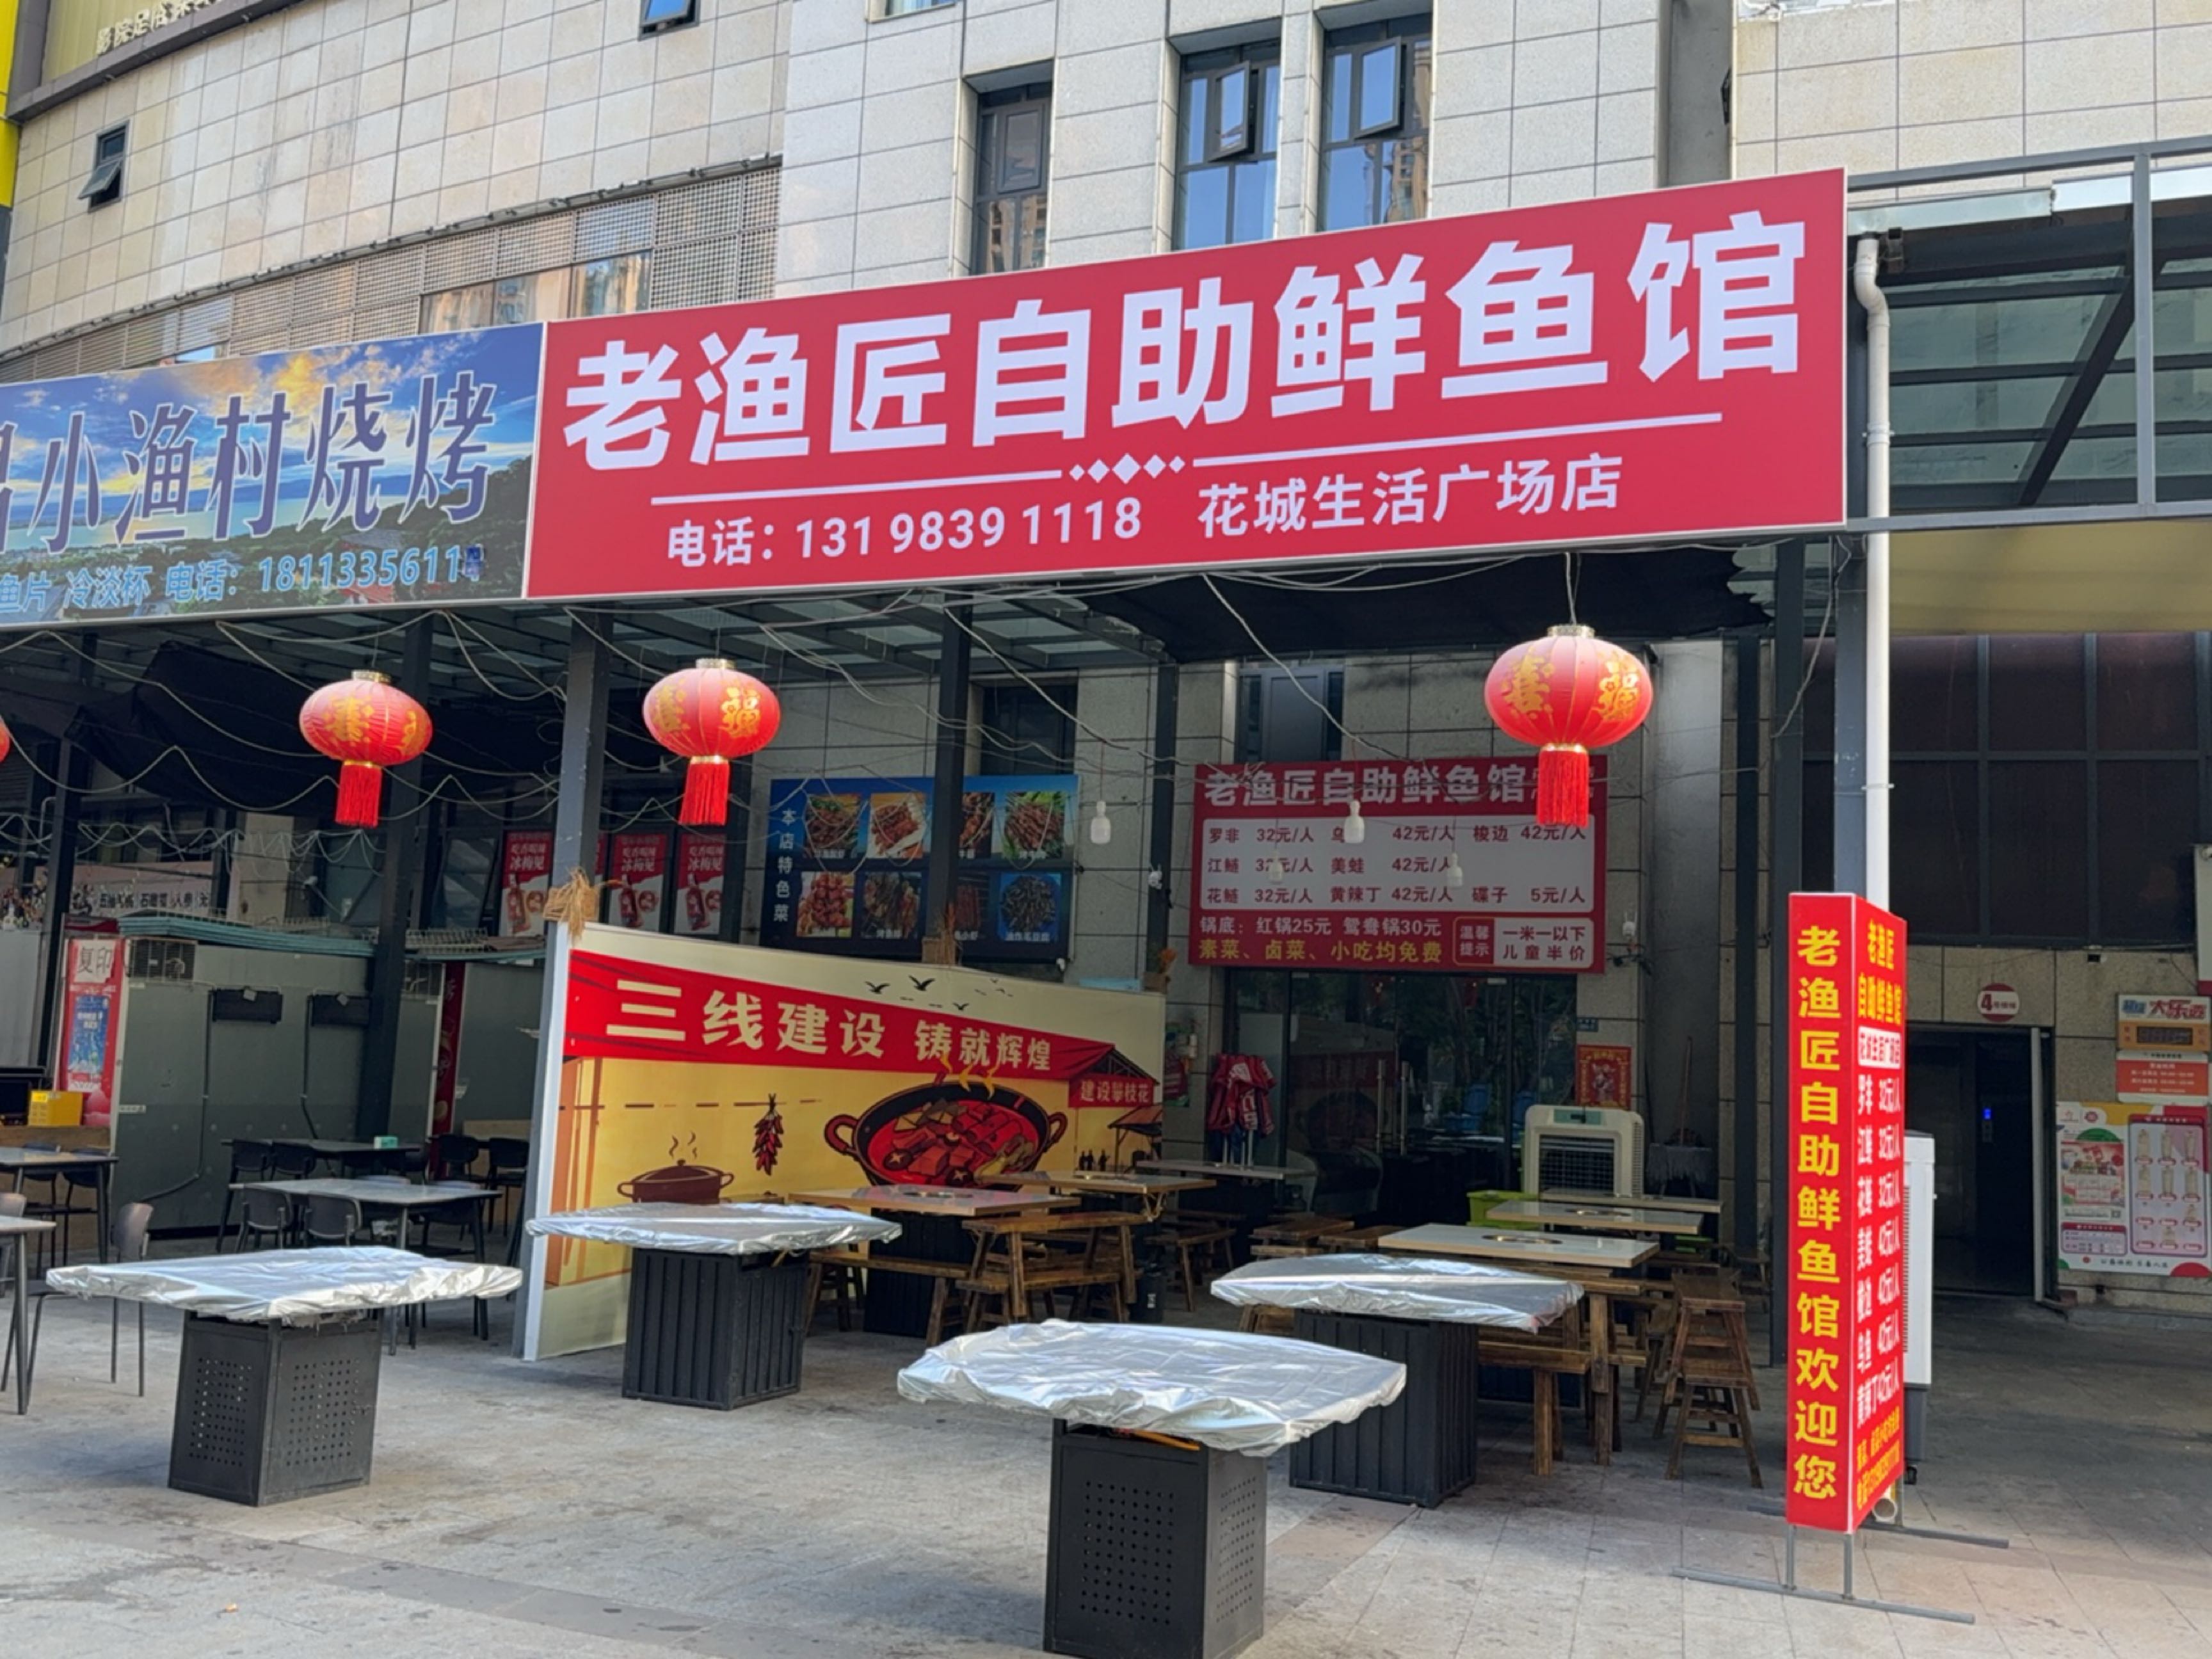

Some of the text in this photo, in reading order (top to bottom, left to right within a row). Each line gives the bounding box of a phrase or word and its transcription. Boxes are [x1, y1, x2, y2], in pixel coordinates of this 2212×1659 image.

[564, 211, 1805, 470] 老渔匠自助鲜鱼馆
[1198, 453, 1623, 539] 花城生活广场店
[796, 517, 870, 559] 131
[890, 507, 1005, 553] 9839
[1022, 497, 1142, 545] 1118
[65, 565, 152, 609] 冷淡杯
[1205, 764, 1526, 807] 老渔匠自助鲜鱼馆
[1208, 827, 1240, 843] 罗非
[1256, 827, 1314, 843] 32元/人
[1392, 825, 1454, 841] 42元/人
[1473, 825, 1509, 842] 梭边
[1521, 825, 1586, 840] 42元/人
[773, 807, 797, 923] 本店特色菜
[1331, 858, 1365, 874] 美蛙
[1254, 888, 1313, 904] 32元/人
[1330, 886, 1381, 903] 黄辣丁
[1391, 886, 1453, 903] 42元/人
[1472, 886, 1508, 904] 碟子
[1530, 886, 1585, 904] 5元/人
[1256, 916, 1332, 936] 红锅25元
[1343, 916, 1442, 937] 鸳鸯锅30元
[1503, 926, 1585, 941] 一米一以下
[77, 946, 113, 974] 复印
[1503, 944, 1585, 961] 儿童半价
[606, 979, 1052, 1072] 三线建设 铸就辉煌
[1080, 1078, 1150, 1104] 建设攀枝花
[1793, 926, 1841, 1500] 老渔匠自助鲜鱼馆欢迎您
